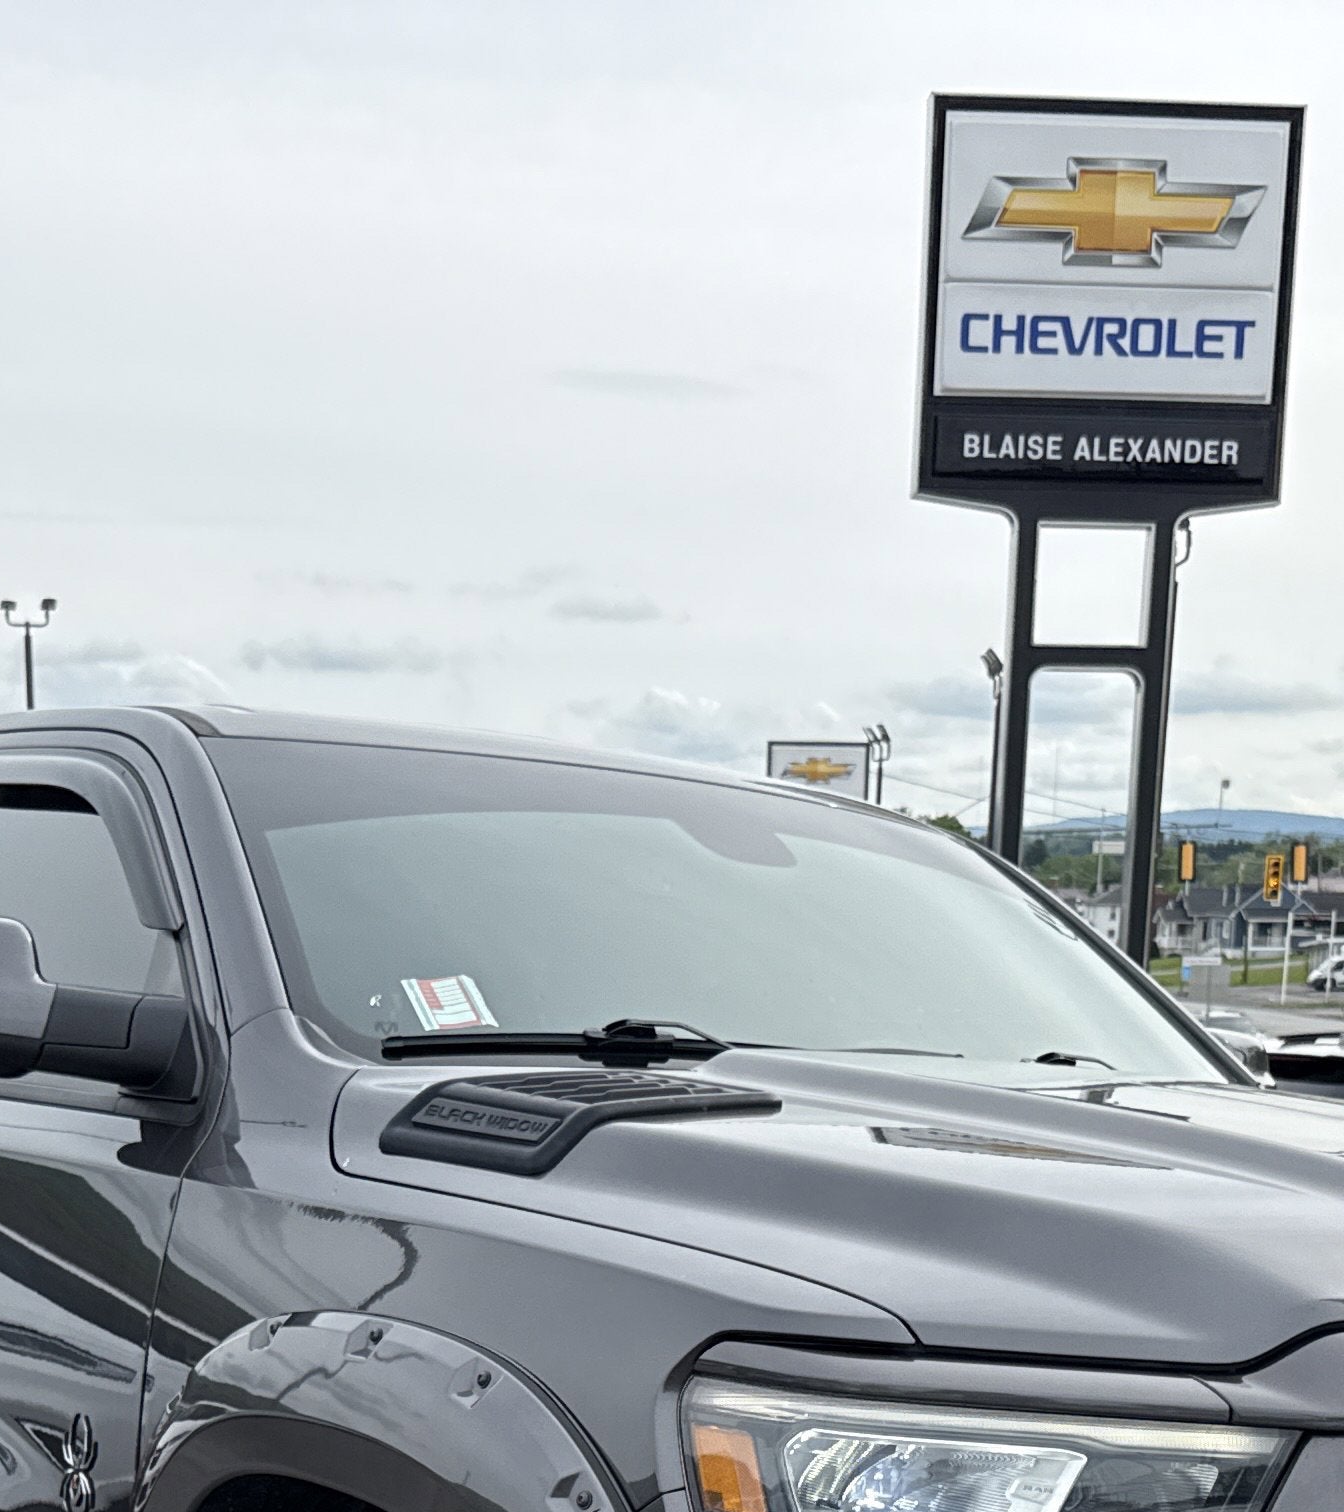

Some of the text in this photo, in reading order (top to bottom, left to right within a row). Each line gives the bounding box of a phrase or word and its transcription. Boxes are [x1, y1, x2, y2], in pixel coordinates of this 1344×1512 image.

[960, 313, 1256, 360] CHEVROLET
[962, 434, 1240, 465] BLAISE ALEXANDER
[425, 1104, 550, 1134] BLACK WIDOW
